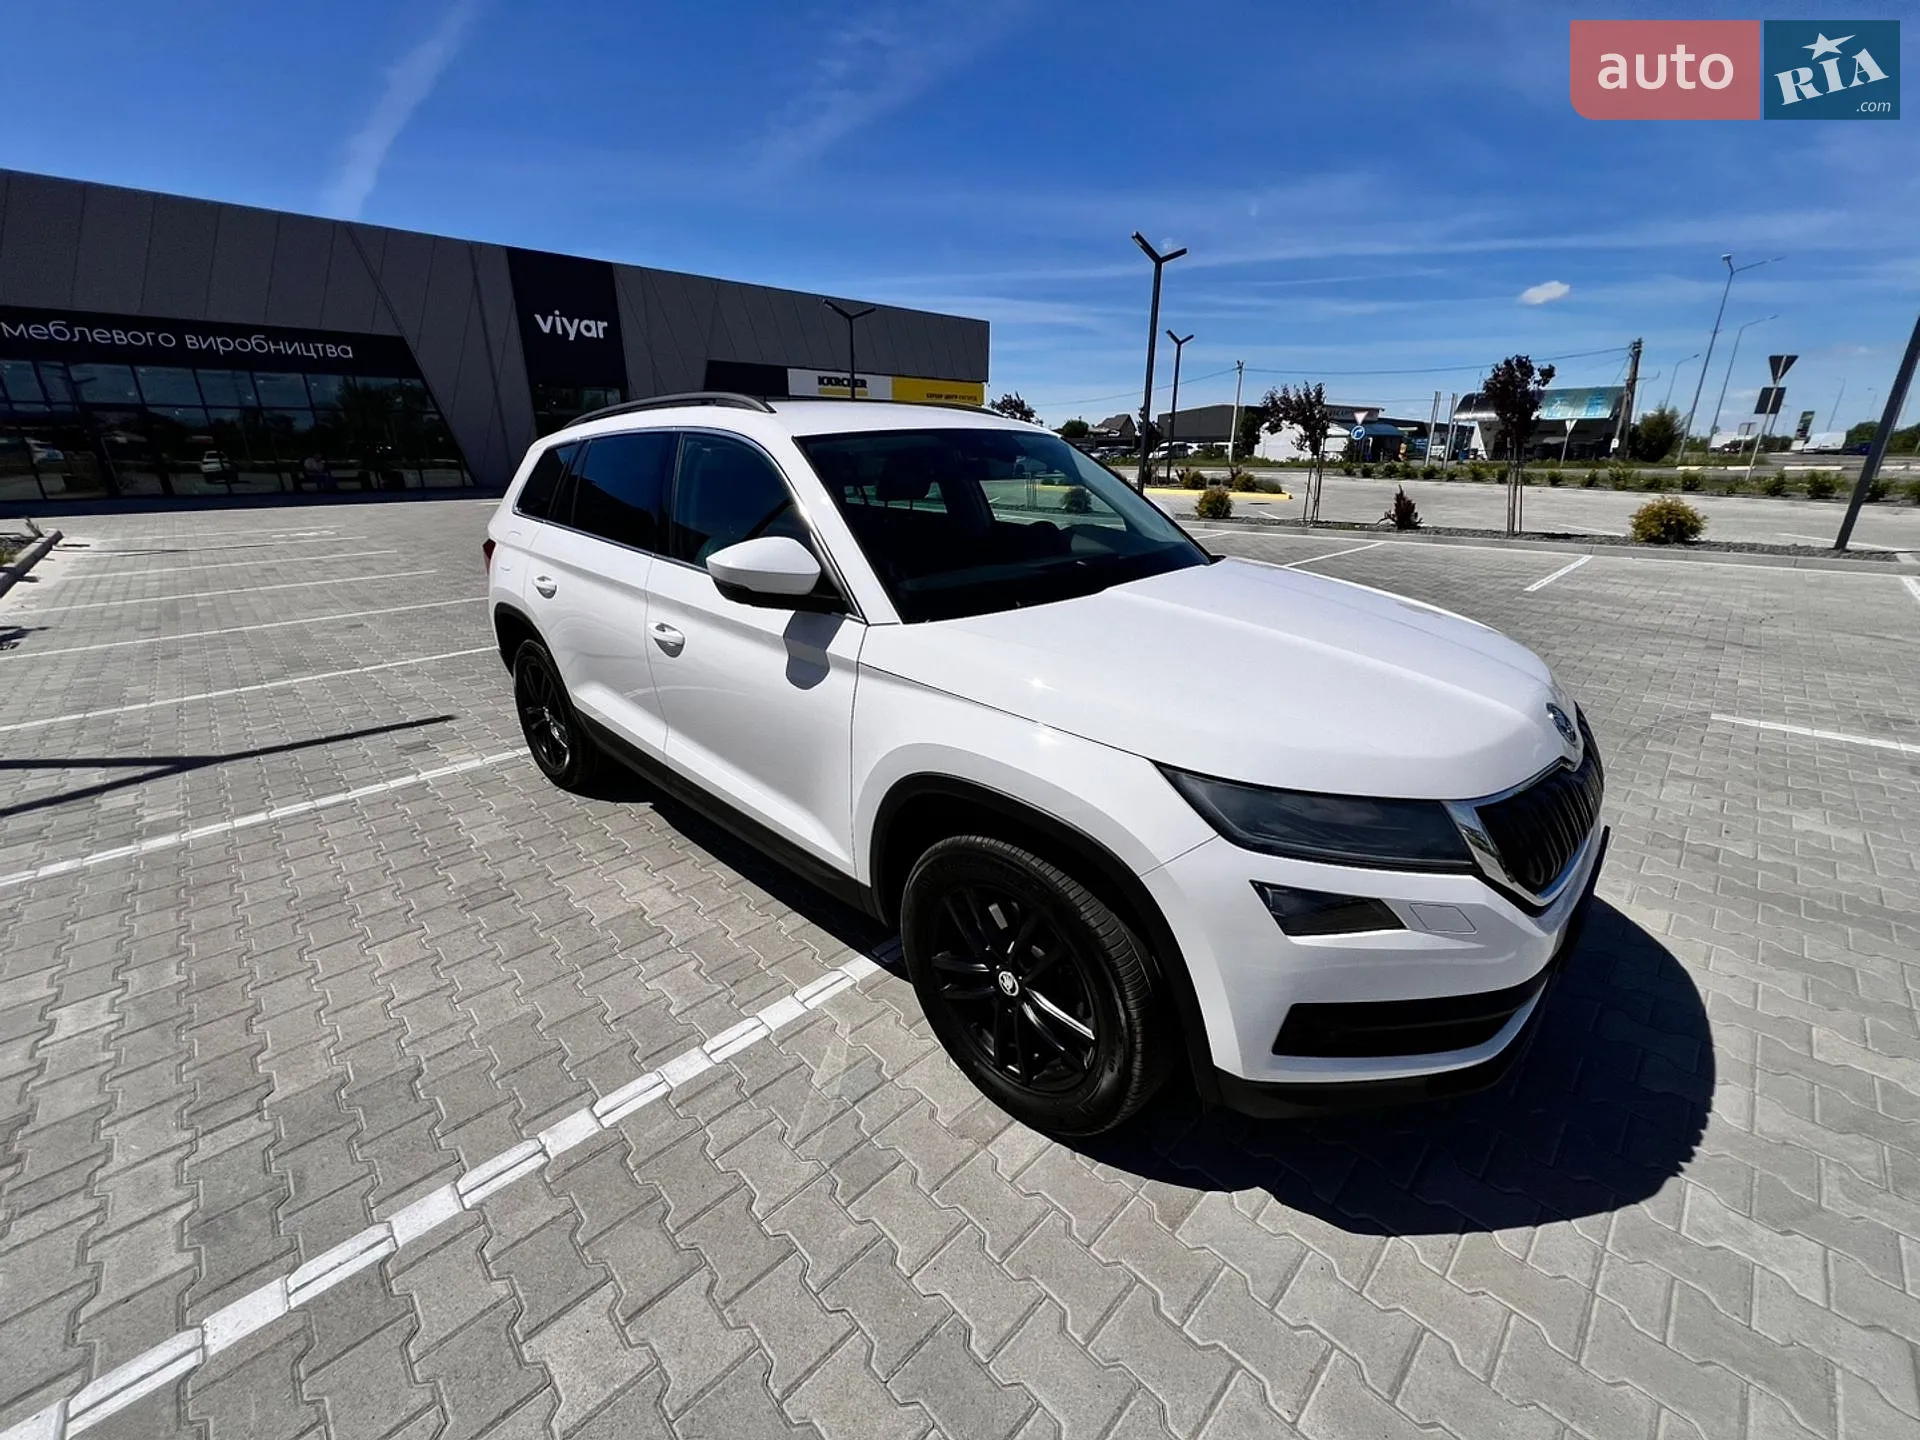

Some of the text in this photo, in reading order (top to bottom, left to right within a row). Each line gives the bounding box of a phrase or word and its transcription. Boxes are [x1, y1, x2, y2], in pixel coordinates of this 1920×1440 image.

[0, 320, 354, 360] меблевого виробництва
[534, 309, 608, 341] viyar
